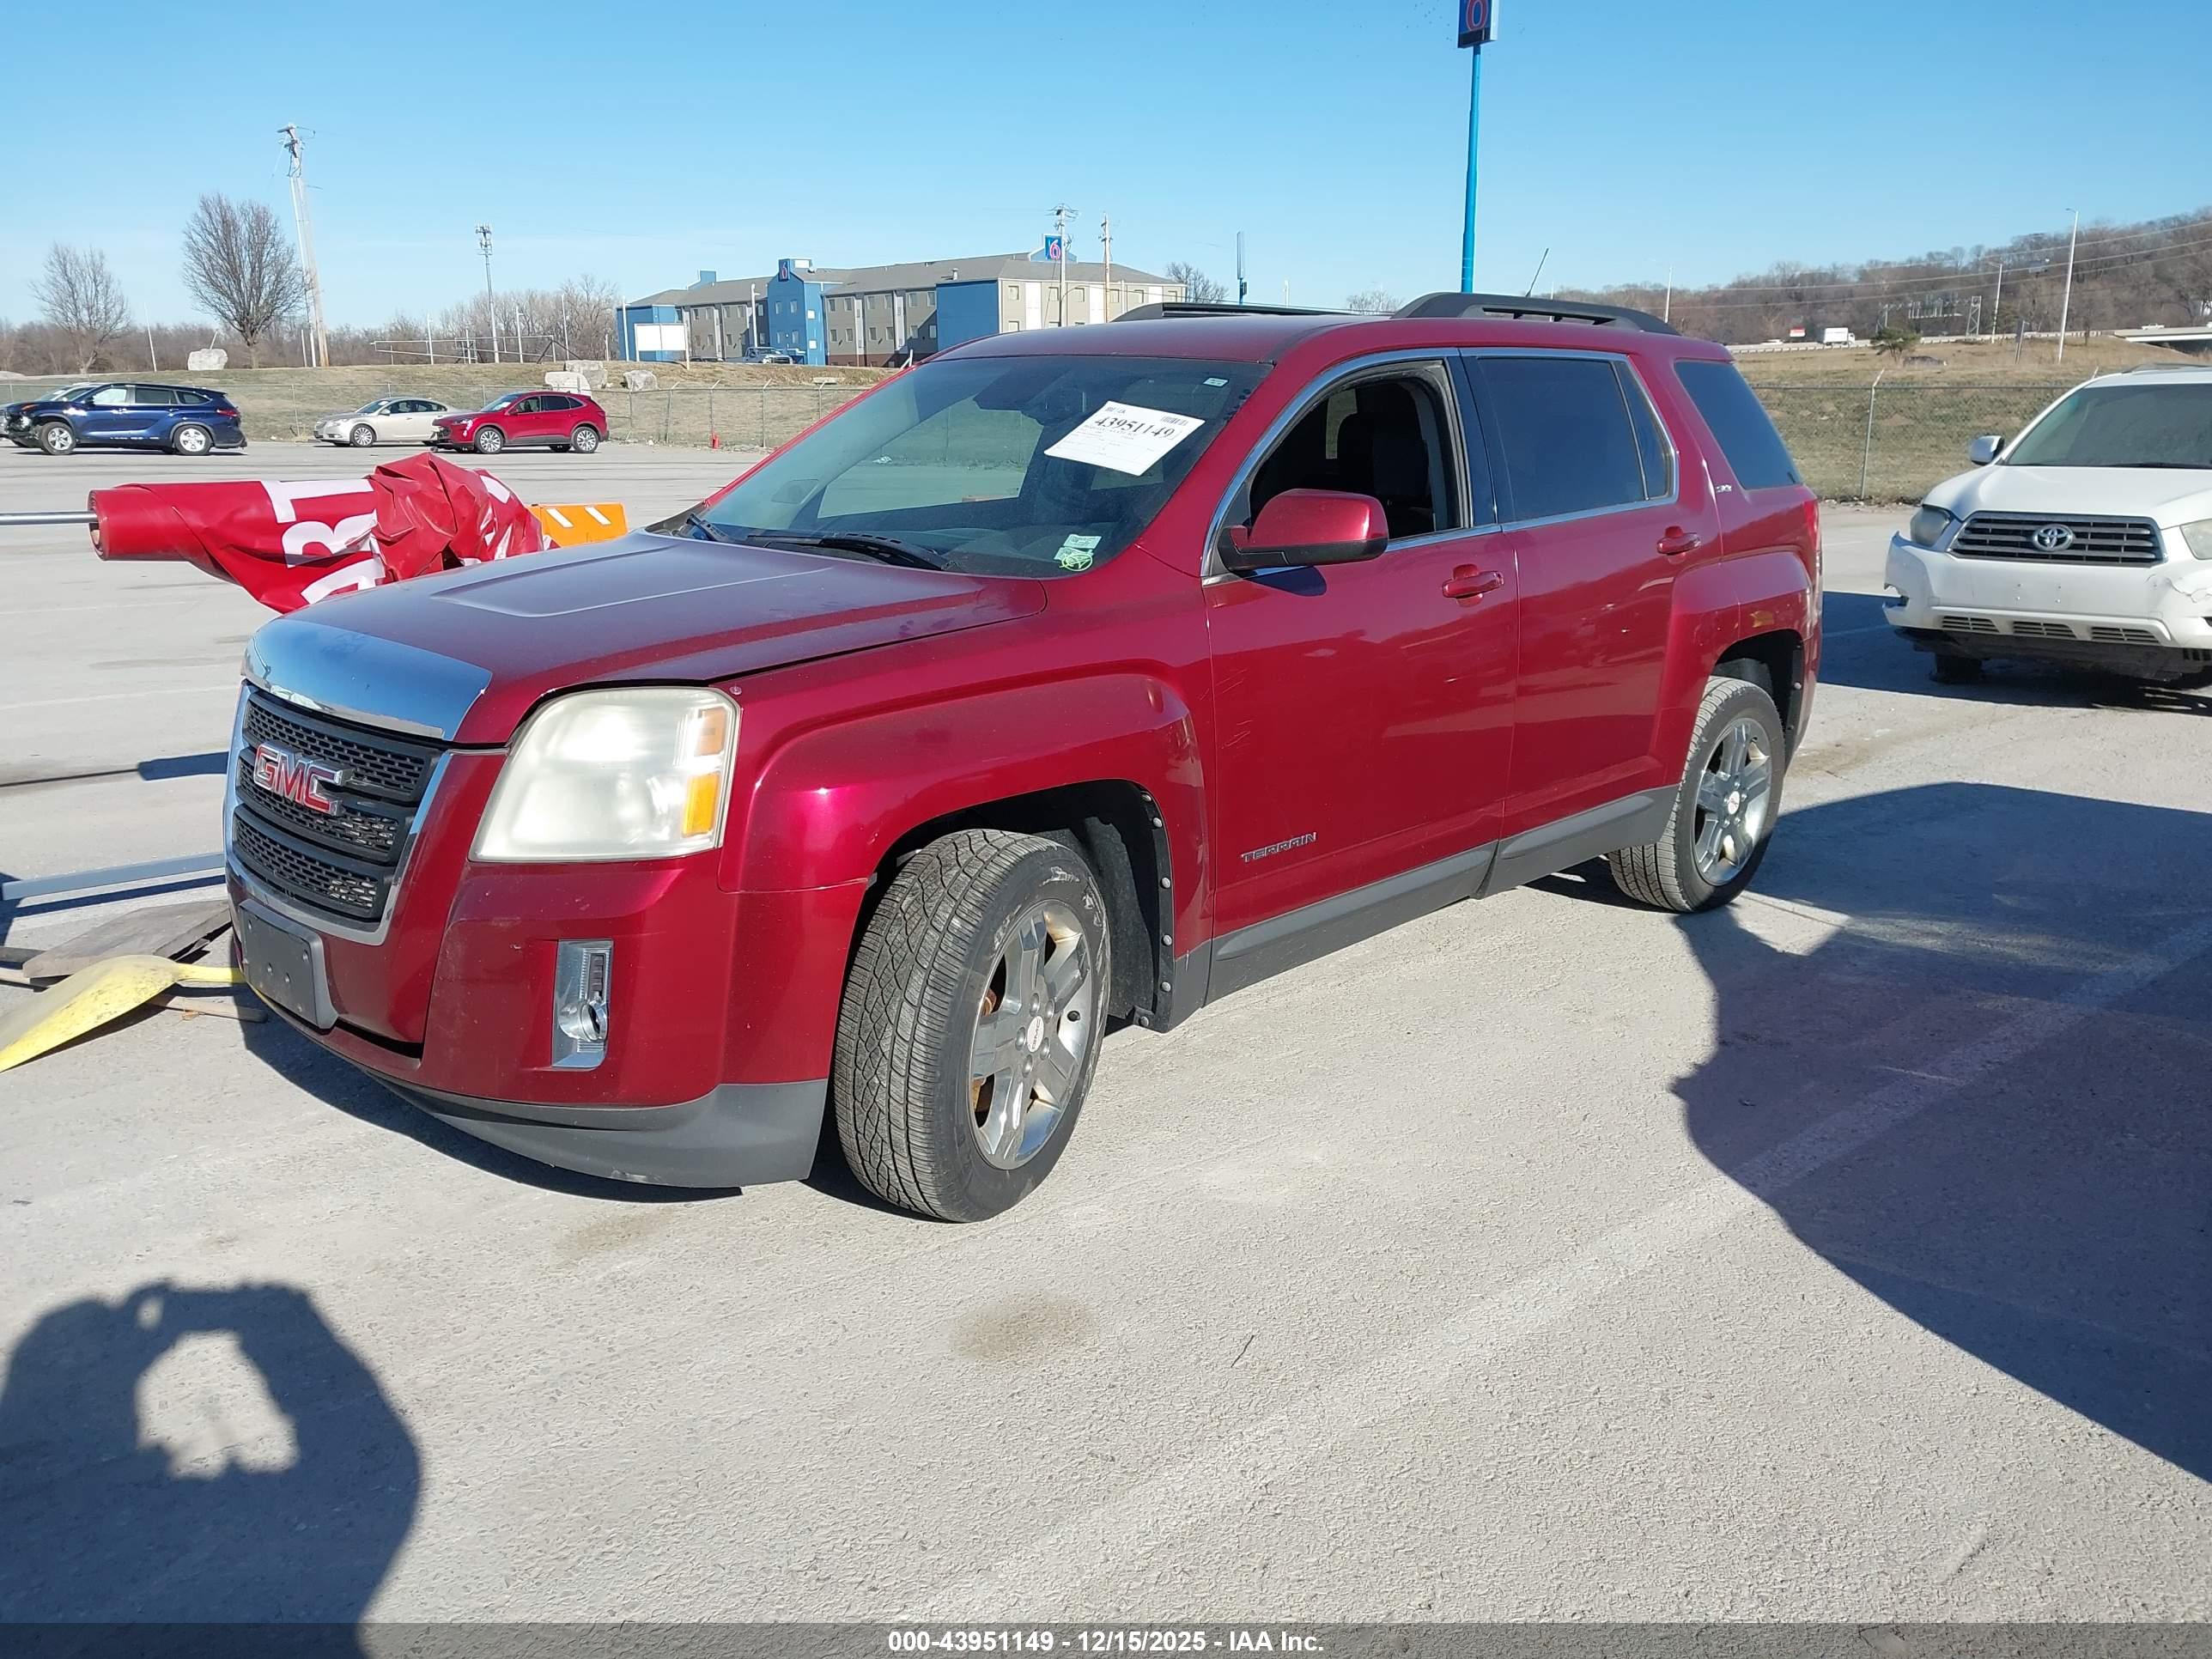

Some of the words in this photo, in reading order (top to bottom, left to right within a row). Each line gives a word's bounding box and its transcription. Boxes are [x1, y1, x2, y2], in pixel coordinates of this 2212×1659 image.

[1049, 239, 1061, 261] 6
[1094, 416, 1176, 438] 43951149
[253, 744, 343, 816] GMC
[1241, 831, 1317, 862] TERRAIN
